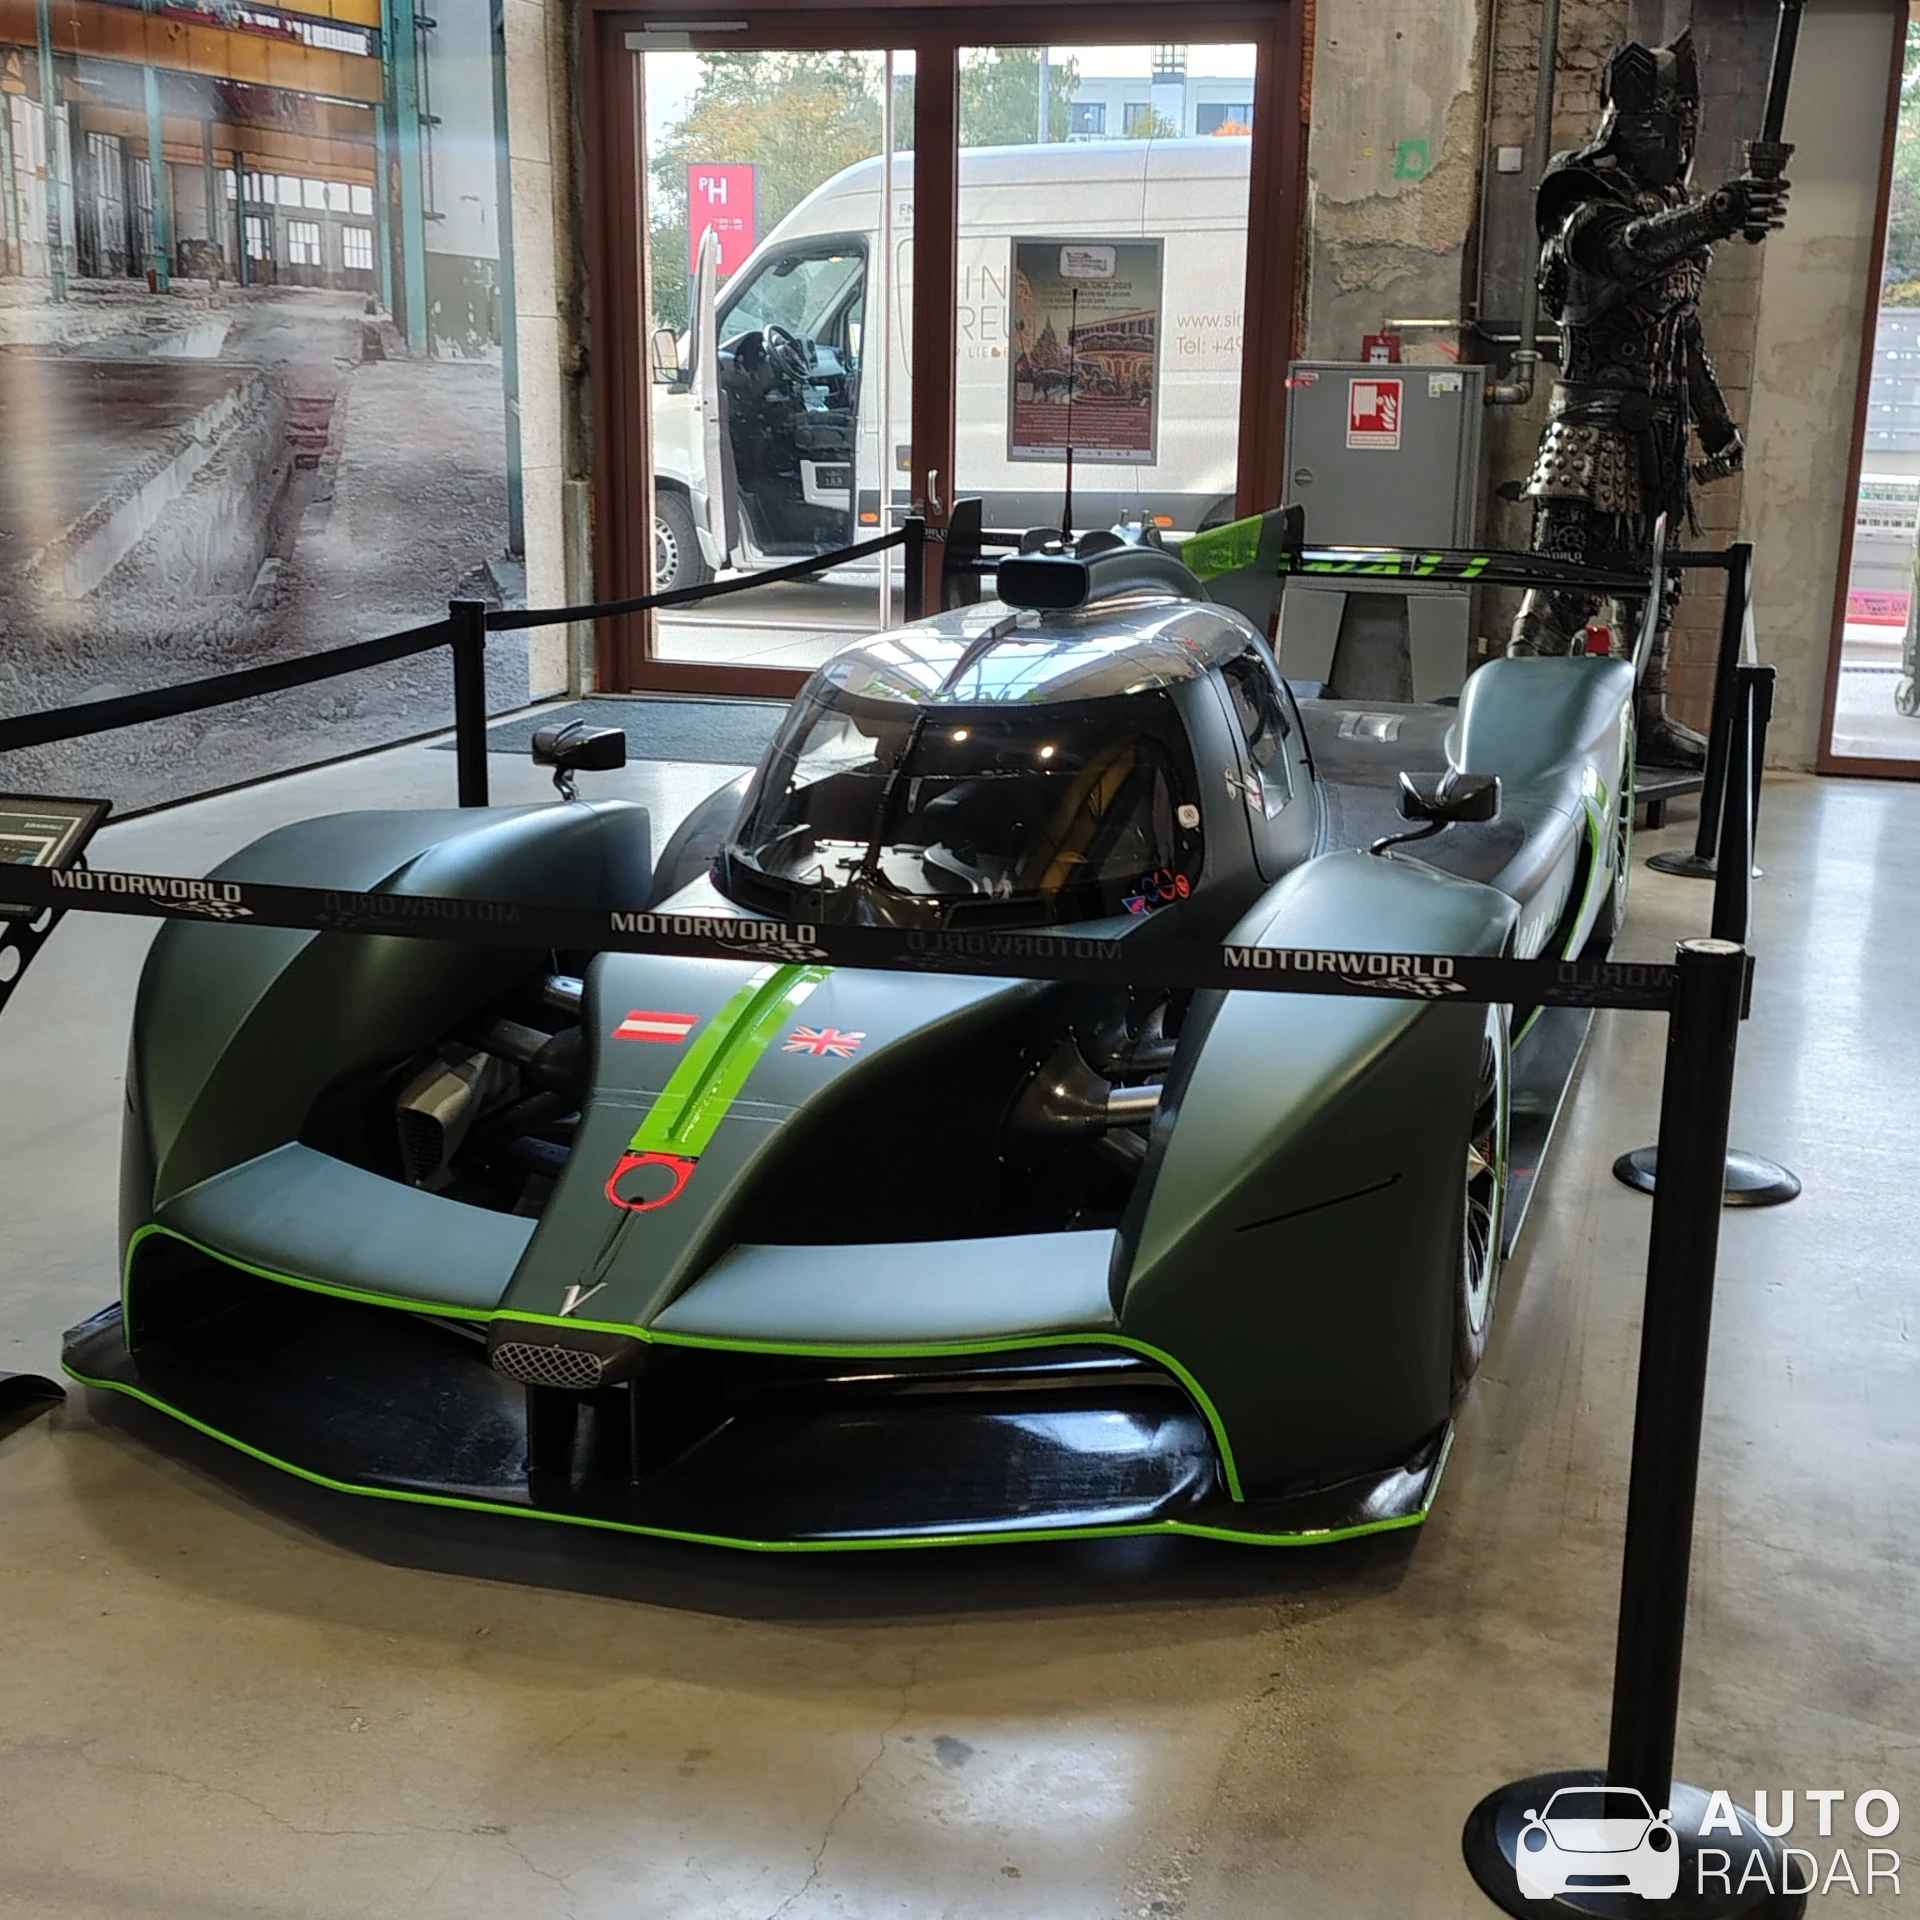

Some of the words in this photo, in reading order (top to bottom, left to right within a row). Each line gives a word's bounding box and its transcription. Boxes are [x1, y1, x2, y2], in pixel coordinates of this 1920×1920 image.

[1176, 336, 1206, 354] Tel:
[51, 869, 242, 902] MOTORWORLD
[610, 912, 817, 944] MOTORWORLD
[1224, 948, 1454, 978] MOTORWORLD
